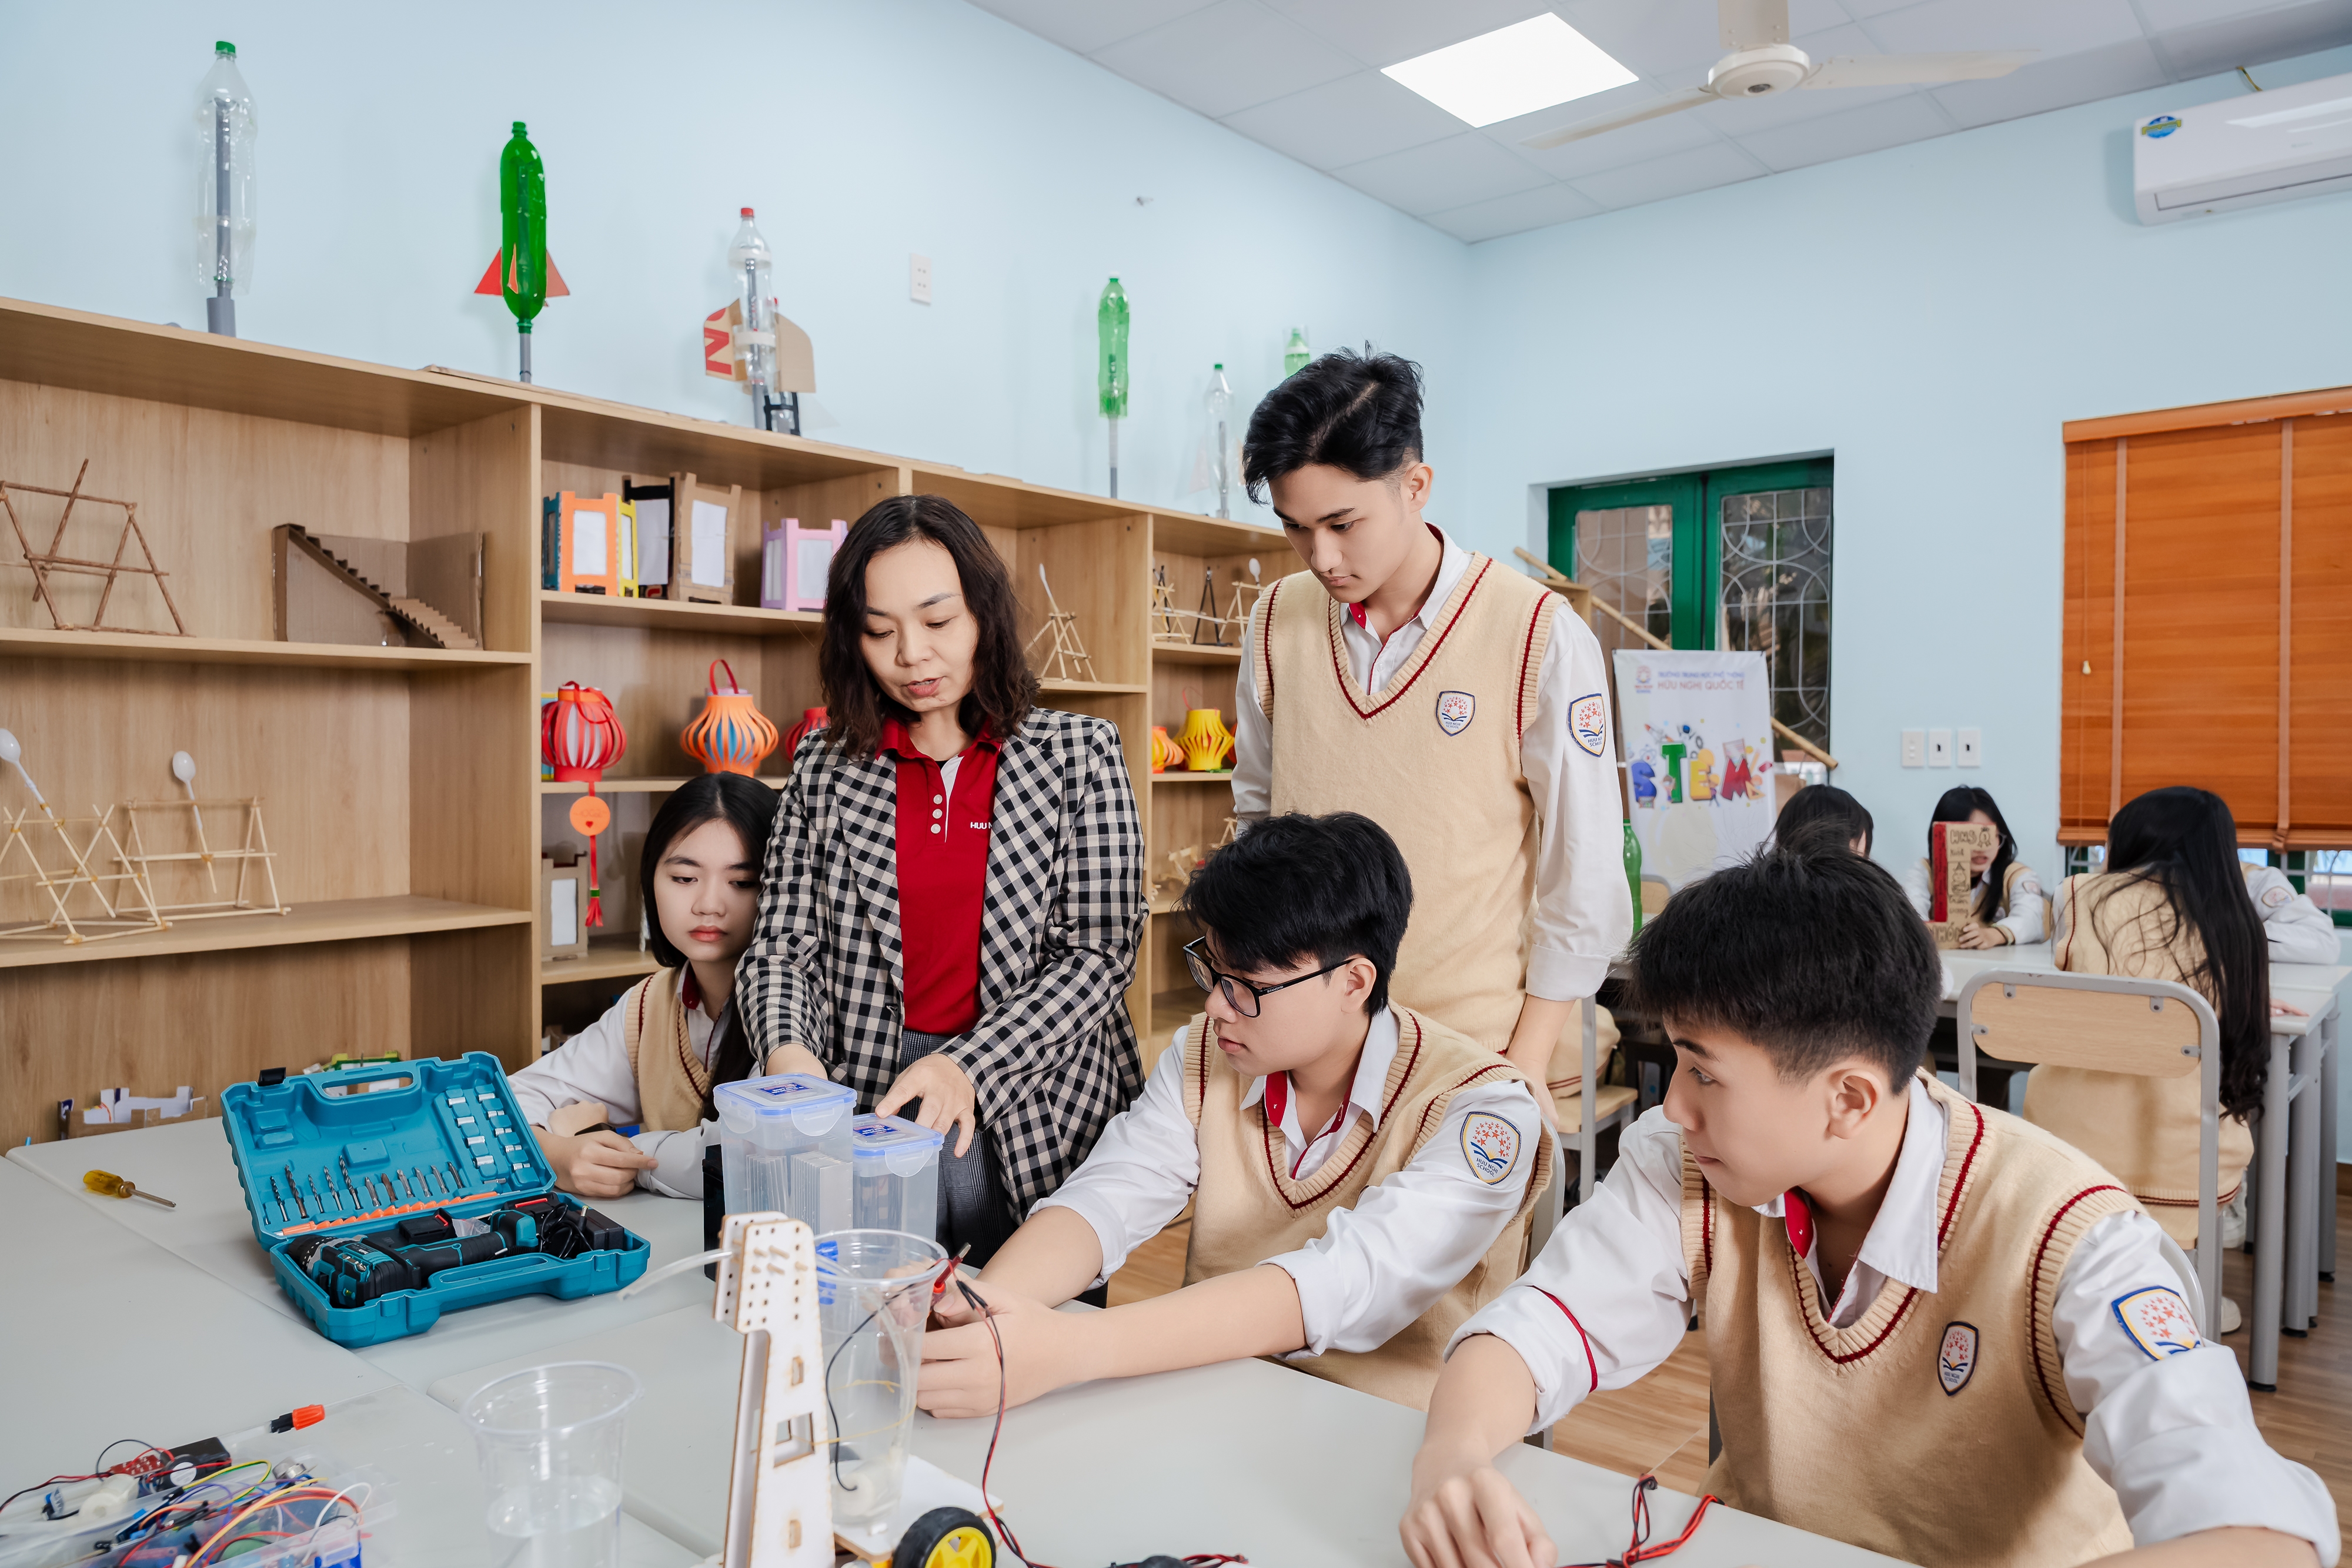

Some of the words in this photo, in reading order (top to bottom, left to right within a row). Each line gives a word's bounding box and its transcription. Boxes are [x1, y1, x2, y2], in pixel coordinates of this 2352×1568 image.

[1476, 1158, 1488, 1166] HUU
[1488, 1164, 1498, 1174] NGHI
[1476, 1164, 1495, 1177] SCHOOL
